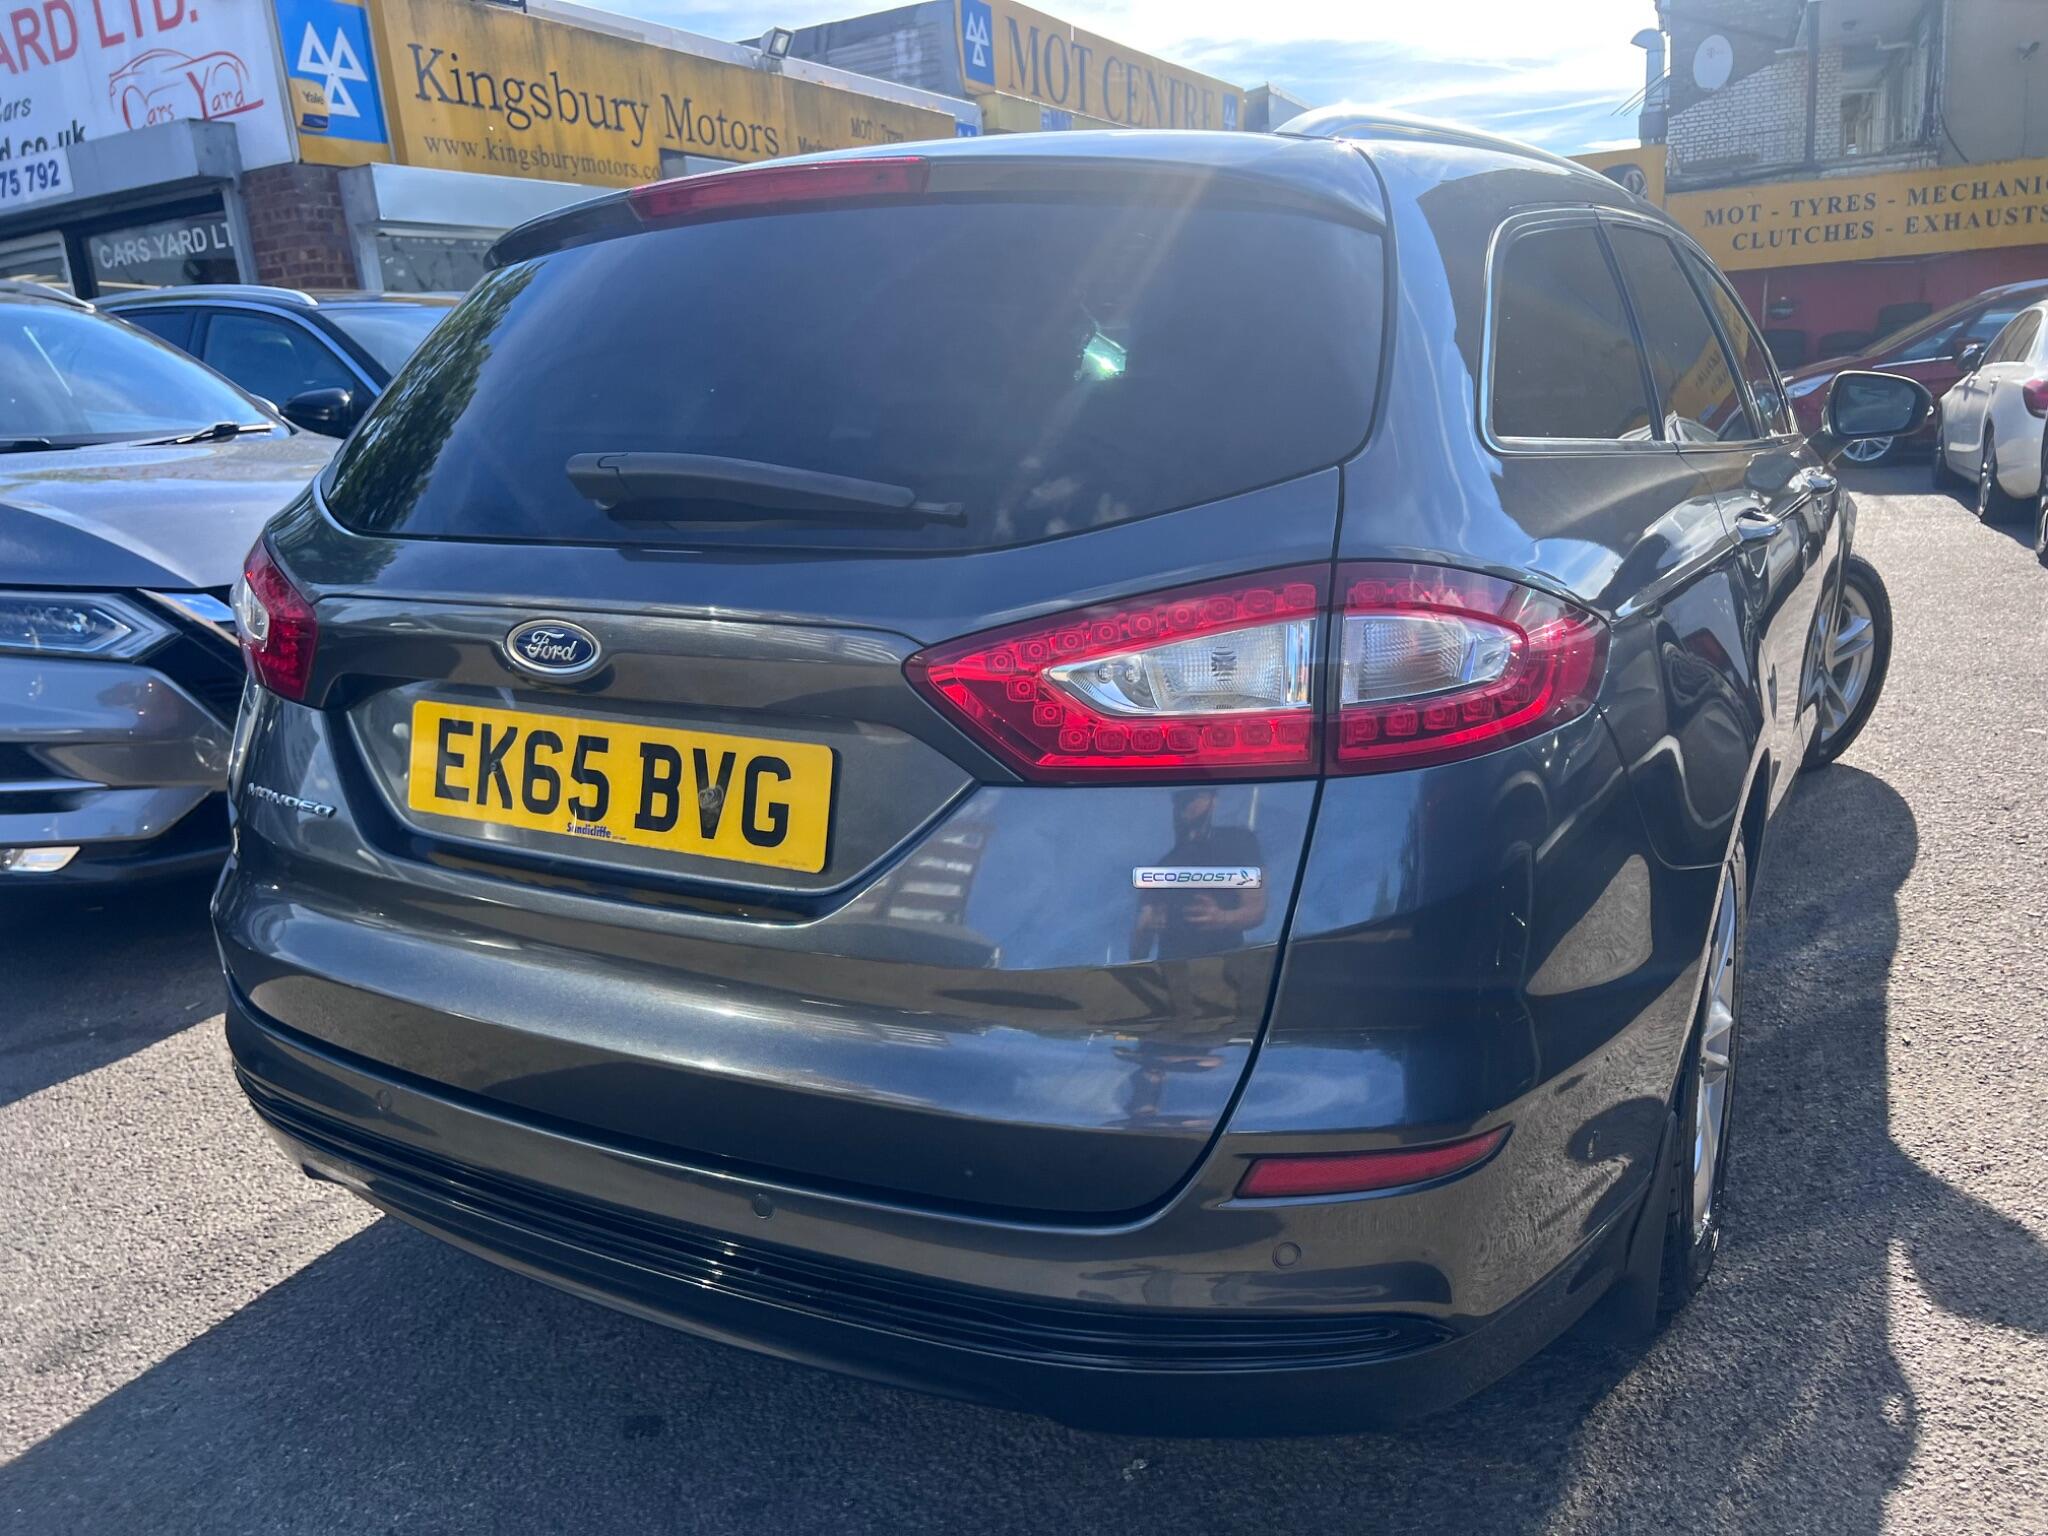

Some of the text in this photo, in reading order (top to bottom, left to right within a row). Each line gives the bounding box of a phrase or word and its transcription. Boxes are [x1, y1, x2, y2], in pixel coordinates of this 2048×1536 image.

[1007, 16, 1215, 129] MOT CENTRE
[0, 97, 31, 122] ars
[407, 44, 779, 156] Kingsbury Motors
[0, 160, 60, 198] 75 792
[1704, 204, 1761, 226] MOT
[1790, 192, 1877, 218] TYRES
[1907, 176, 2048, 206] MECHANI
[100, 238, 150, 268] CARS
[153, 227, 207, 258] YARD
[1732, 221, 1875, 250] CLUTCHES
[1905, 204, 2048, 234] EXHAUSTS
[525, 630, 578, 661] Ford
[434, 718, 792, 848] EK65 BVG
[1141, 872, 1238, 883] ECOBOOST
